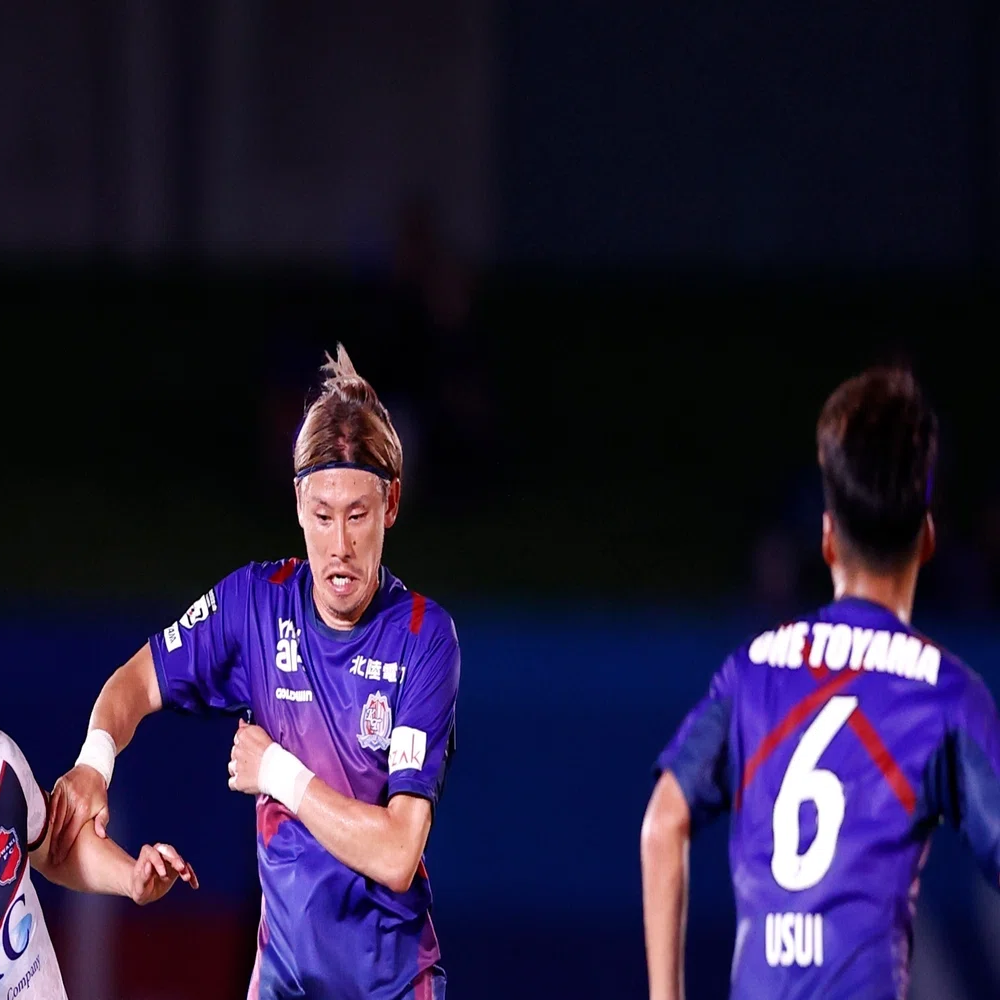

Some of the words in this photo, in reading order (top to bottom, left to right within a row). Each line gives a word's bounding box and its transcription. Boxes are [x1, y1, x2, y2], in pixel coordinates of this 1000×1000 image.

[808, 622, 941, 686] TOYAMA
[771, 695, 858, 892] 6
[765, 911, 824, 968] USUI
